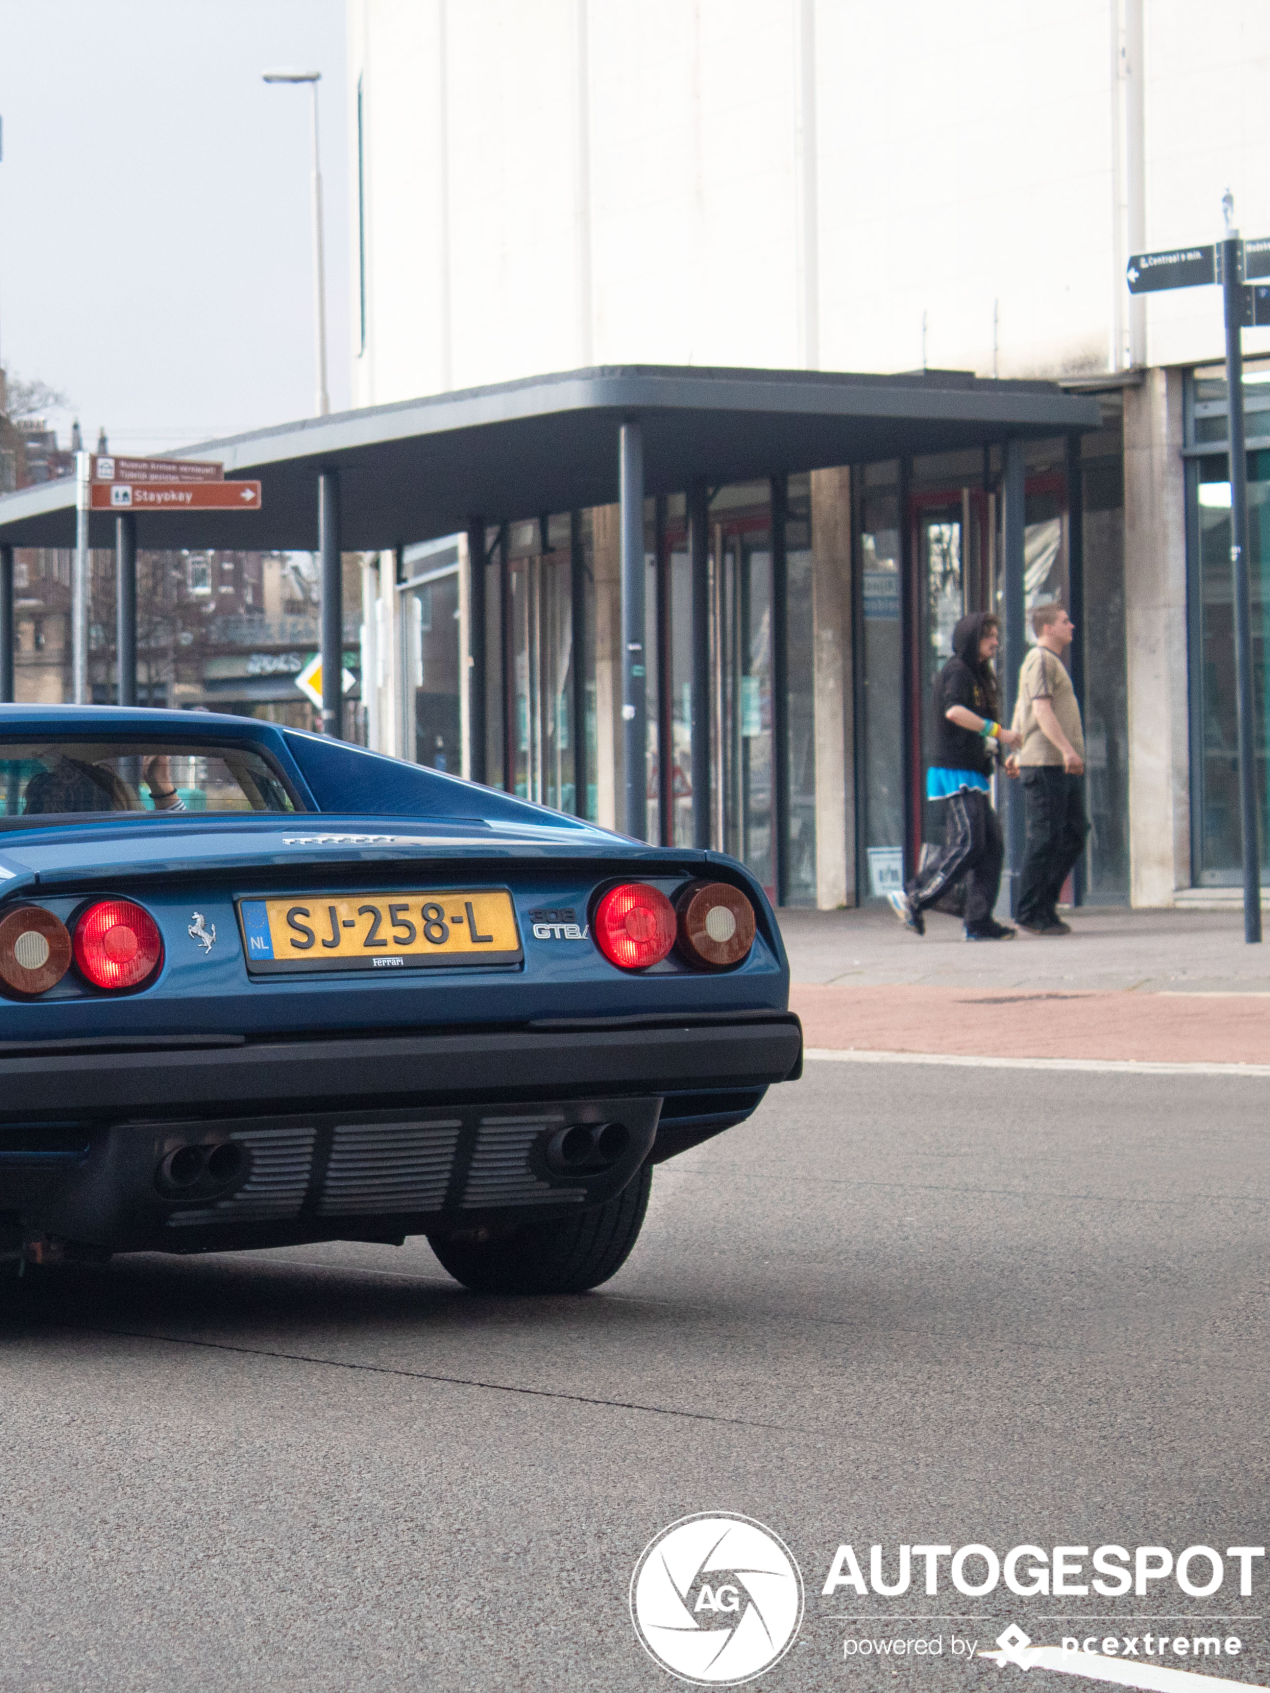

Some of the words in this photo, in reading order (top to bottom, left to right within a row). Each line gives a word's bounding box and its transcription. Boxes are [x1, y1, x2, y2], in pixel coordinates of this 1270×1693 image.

[134, 490, 193, 504] Stayokay
[530, 908, 576, 924] 308
[250, 936, 270, 950] NL
[286, 901, 494, 950] SJ-258-L
[372, 957, 404, 967] Ferrari
